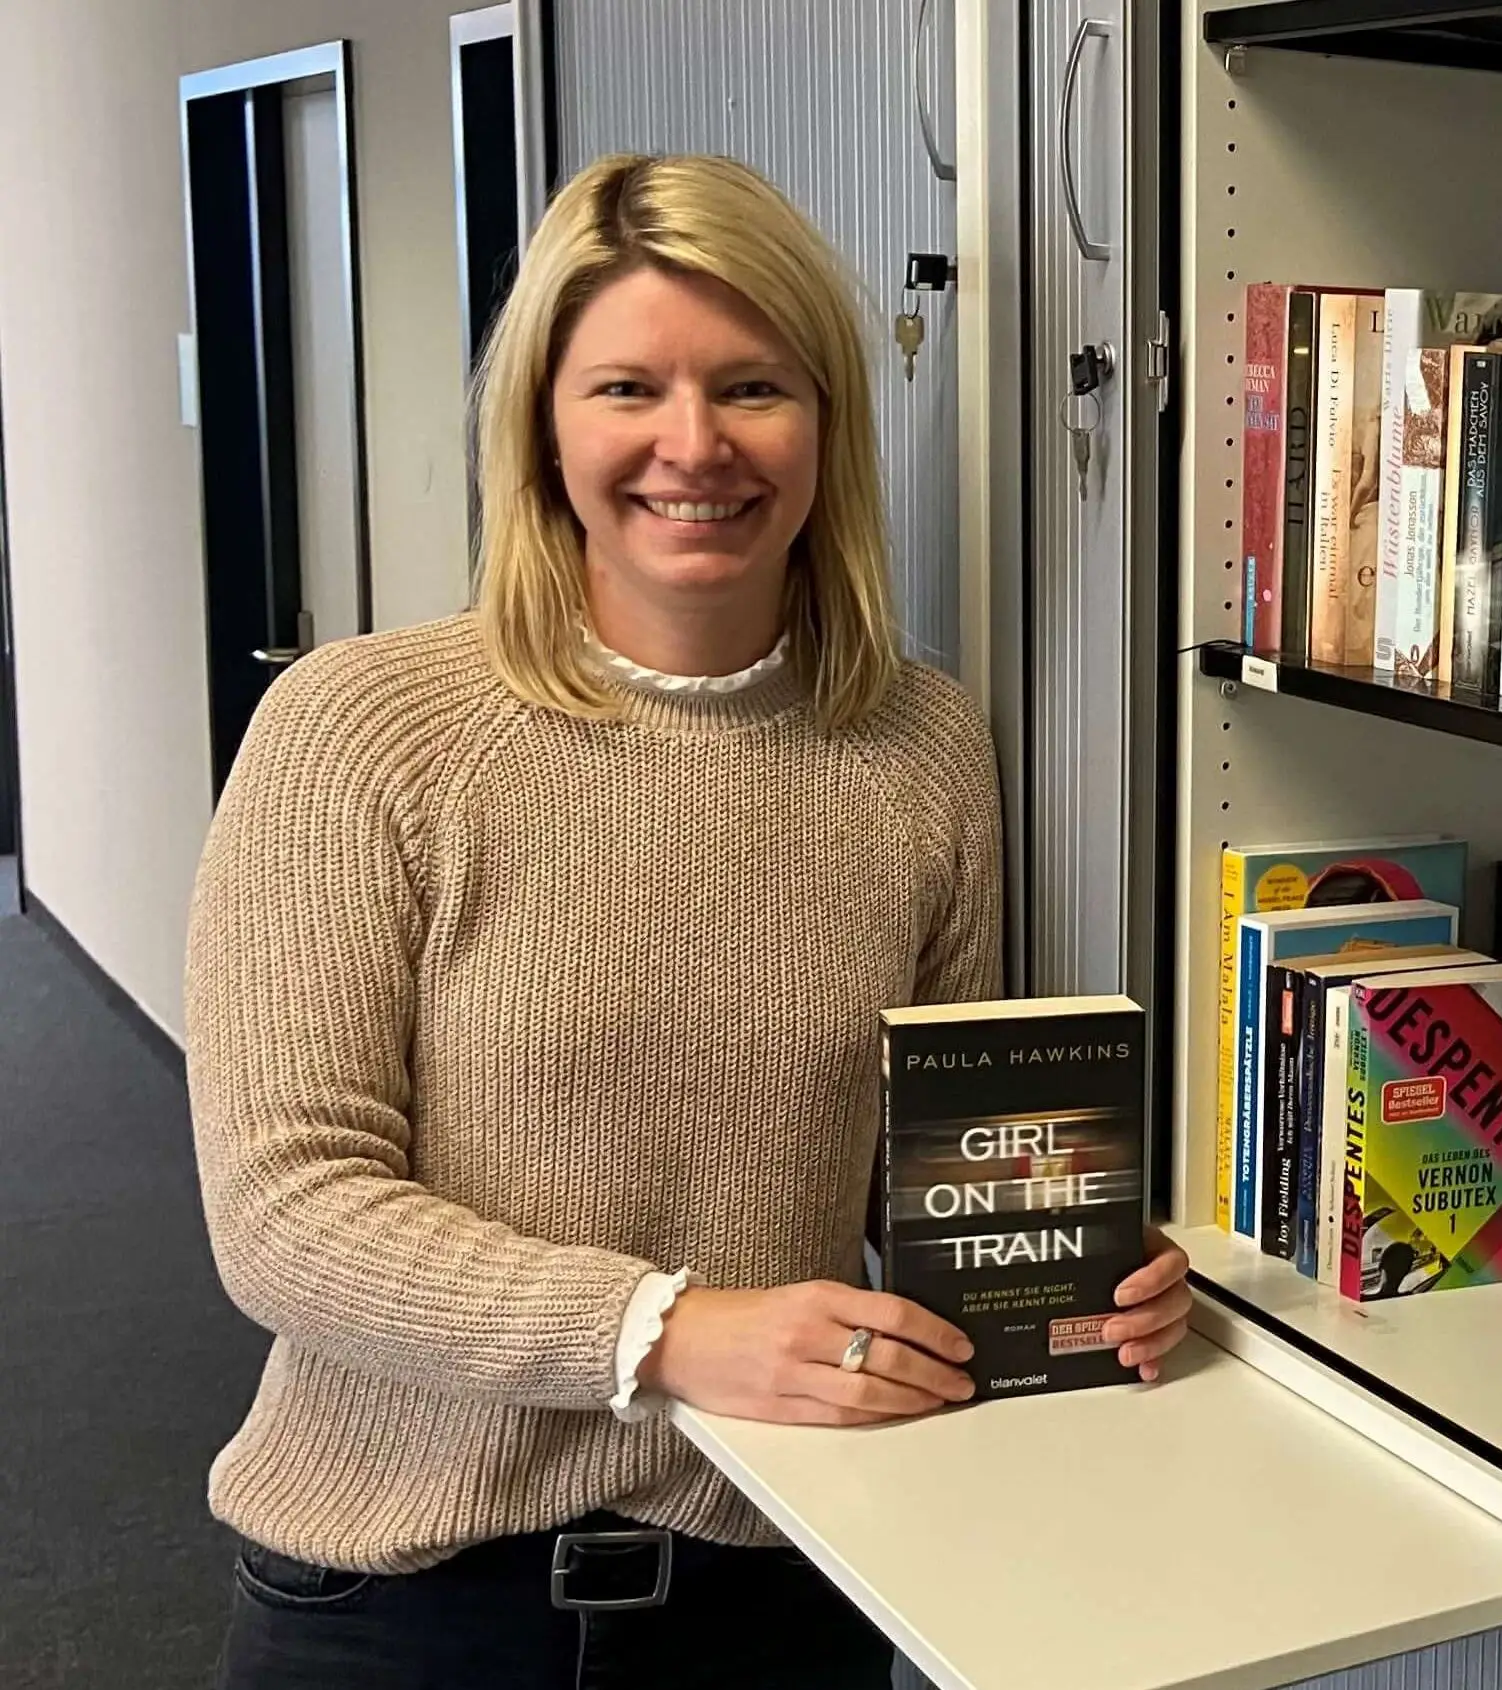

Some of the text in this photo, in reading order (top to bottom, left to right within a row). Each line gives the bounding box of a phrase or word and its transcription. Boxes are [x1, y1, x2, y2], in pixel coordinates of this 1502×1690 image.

[1328, 323, 1341, 448] Luca Di Fulvio
[1475, 381, 1489, 498] AUS DEM SAVOY
[1466, 459, 1477, 487] DAS
[1329, 495, 1340, 527] war
[1382, 405, 1404, 580] Wüstenblume
[1319, 491, 1331, 572] in Italien
[1403, 490, 1418, 577] Jonas Jonasson
[1469, 504, 1480, 565] GAYNOR
[1327, 534, 1340, 600] einmal
[1222, 908, 1235, 943] Am
[1219, 952, 1233, 1026] Malala
[906, 1043, 1130, 1071] PAULA HAWKINS
[1351, 1029, 1361, 1072] VERNON
[1240, 1025, 1254, 1183] TOTENGRÄBERSPÄTZLE
[1388, 1095, 1440, 1110] Bestseller
[1392, 1084, 1436, 1099] SPIEGEL
[960, 1122, 1075, 1162] GIRL
[1422, 1148, 1491, 1164] DAS LEBEN DES
[1342, 1086, 1365, 1260] DESPENTES
[1418, 1162, 1494, 1189] VERNON
[924, 1172, 1109, 1219] ON THE
[1277, 1157, 1292, 1245] Joy Fielding
[1412, 1185, 1497, 1214] SUBUTEX
[1449, 1213, 1456, 1234] 1
[942, 1226, 1083, 1270] TRAIN
[962, 1291, 977, 1301] DU
[979, 1287, 1020, 1300] KENNST
[1023, 1285, 1041, 1295] SIE
[962, 1303, 990, 1314] ABER
[993, 1301, 1010, 1311] SIE
[1012, 1298, 1046, 1309] KENNT
[1003, 1324, 1036, 1333] ROMAN
[1052, 1323, 1073, 1336] DER
[990, 1373, 1049, 1390] blanvalet
